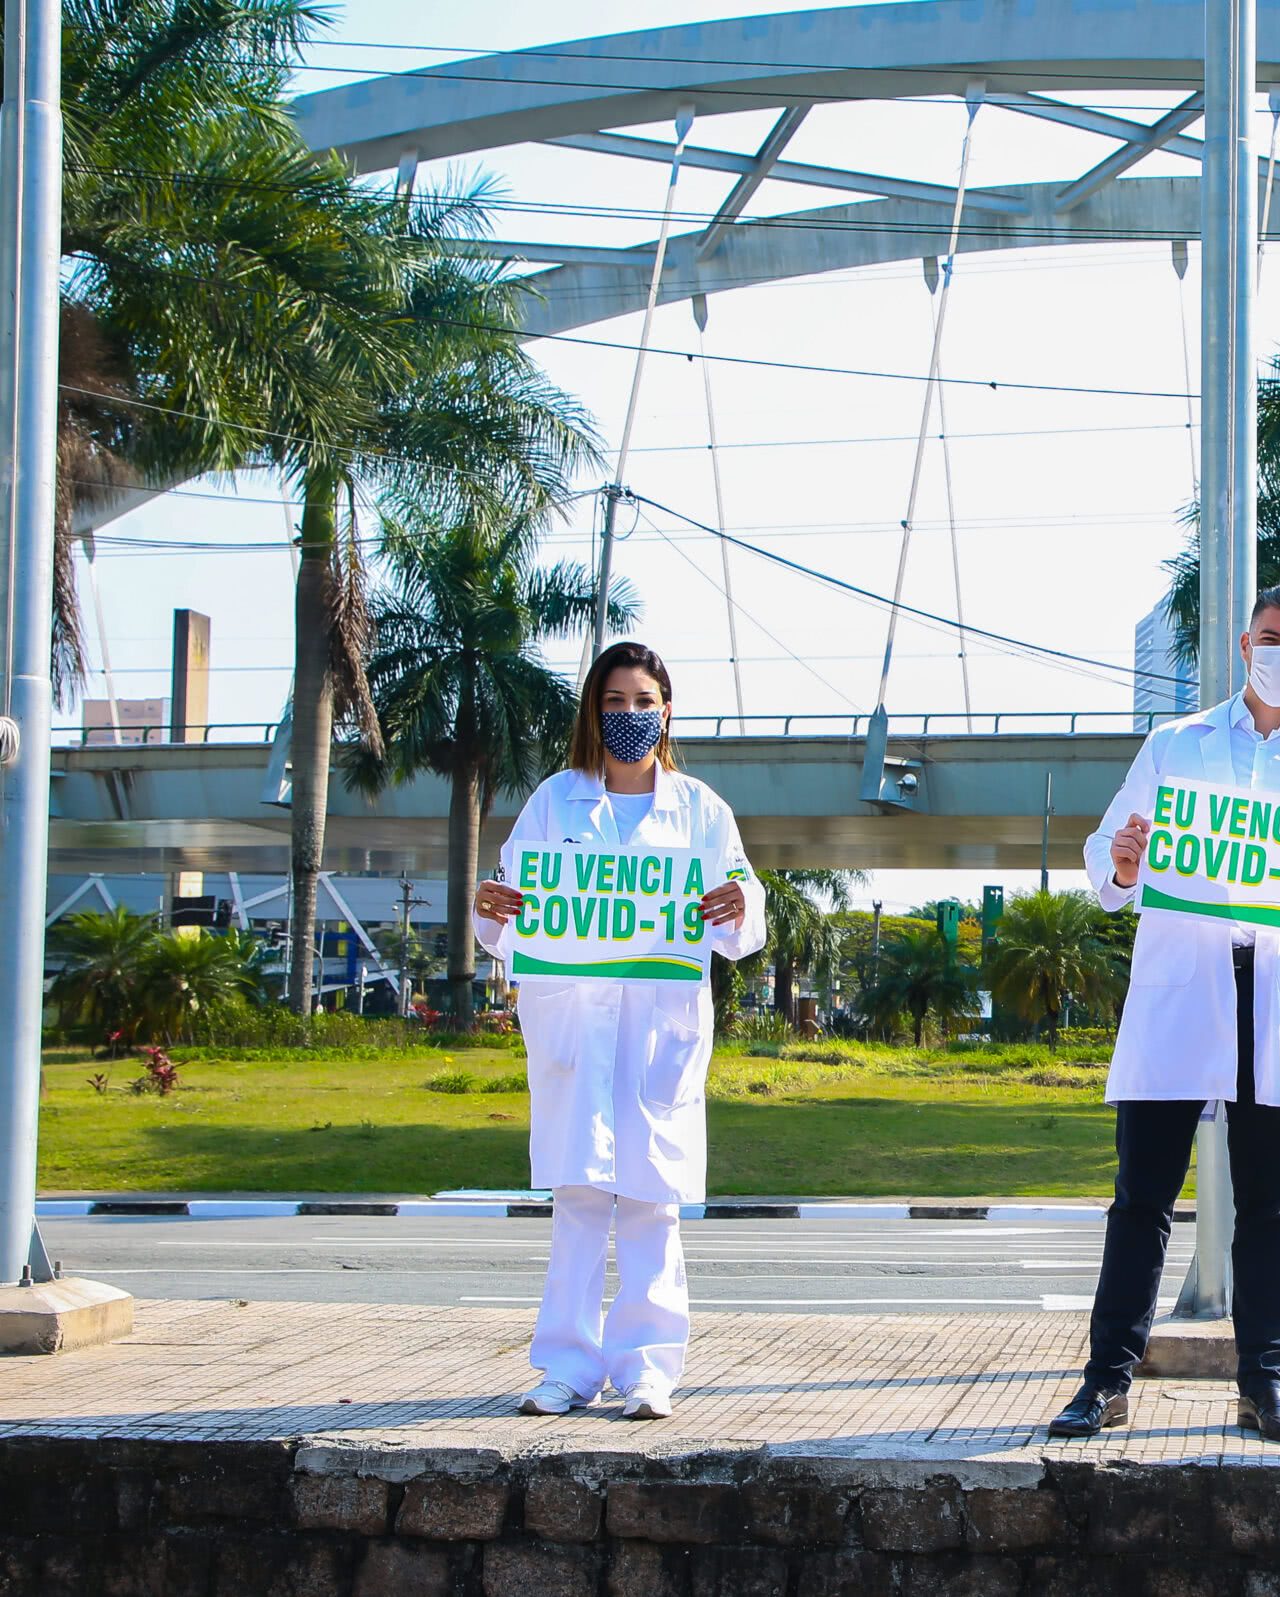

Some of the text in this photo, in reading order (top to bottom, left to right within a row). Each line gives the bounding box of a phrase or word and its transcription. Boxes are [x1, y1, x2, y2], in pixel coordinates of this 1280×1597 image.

[1153, 785, 1197, 831] EU
[519, 850, 563, 892] EU
[574, 853, 673, 897] VENCI
[683, 857, 705, 897] A
[515, 894, 705, 945] COVID-19
